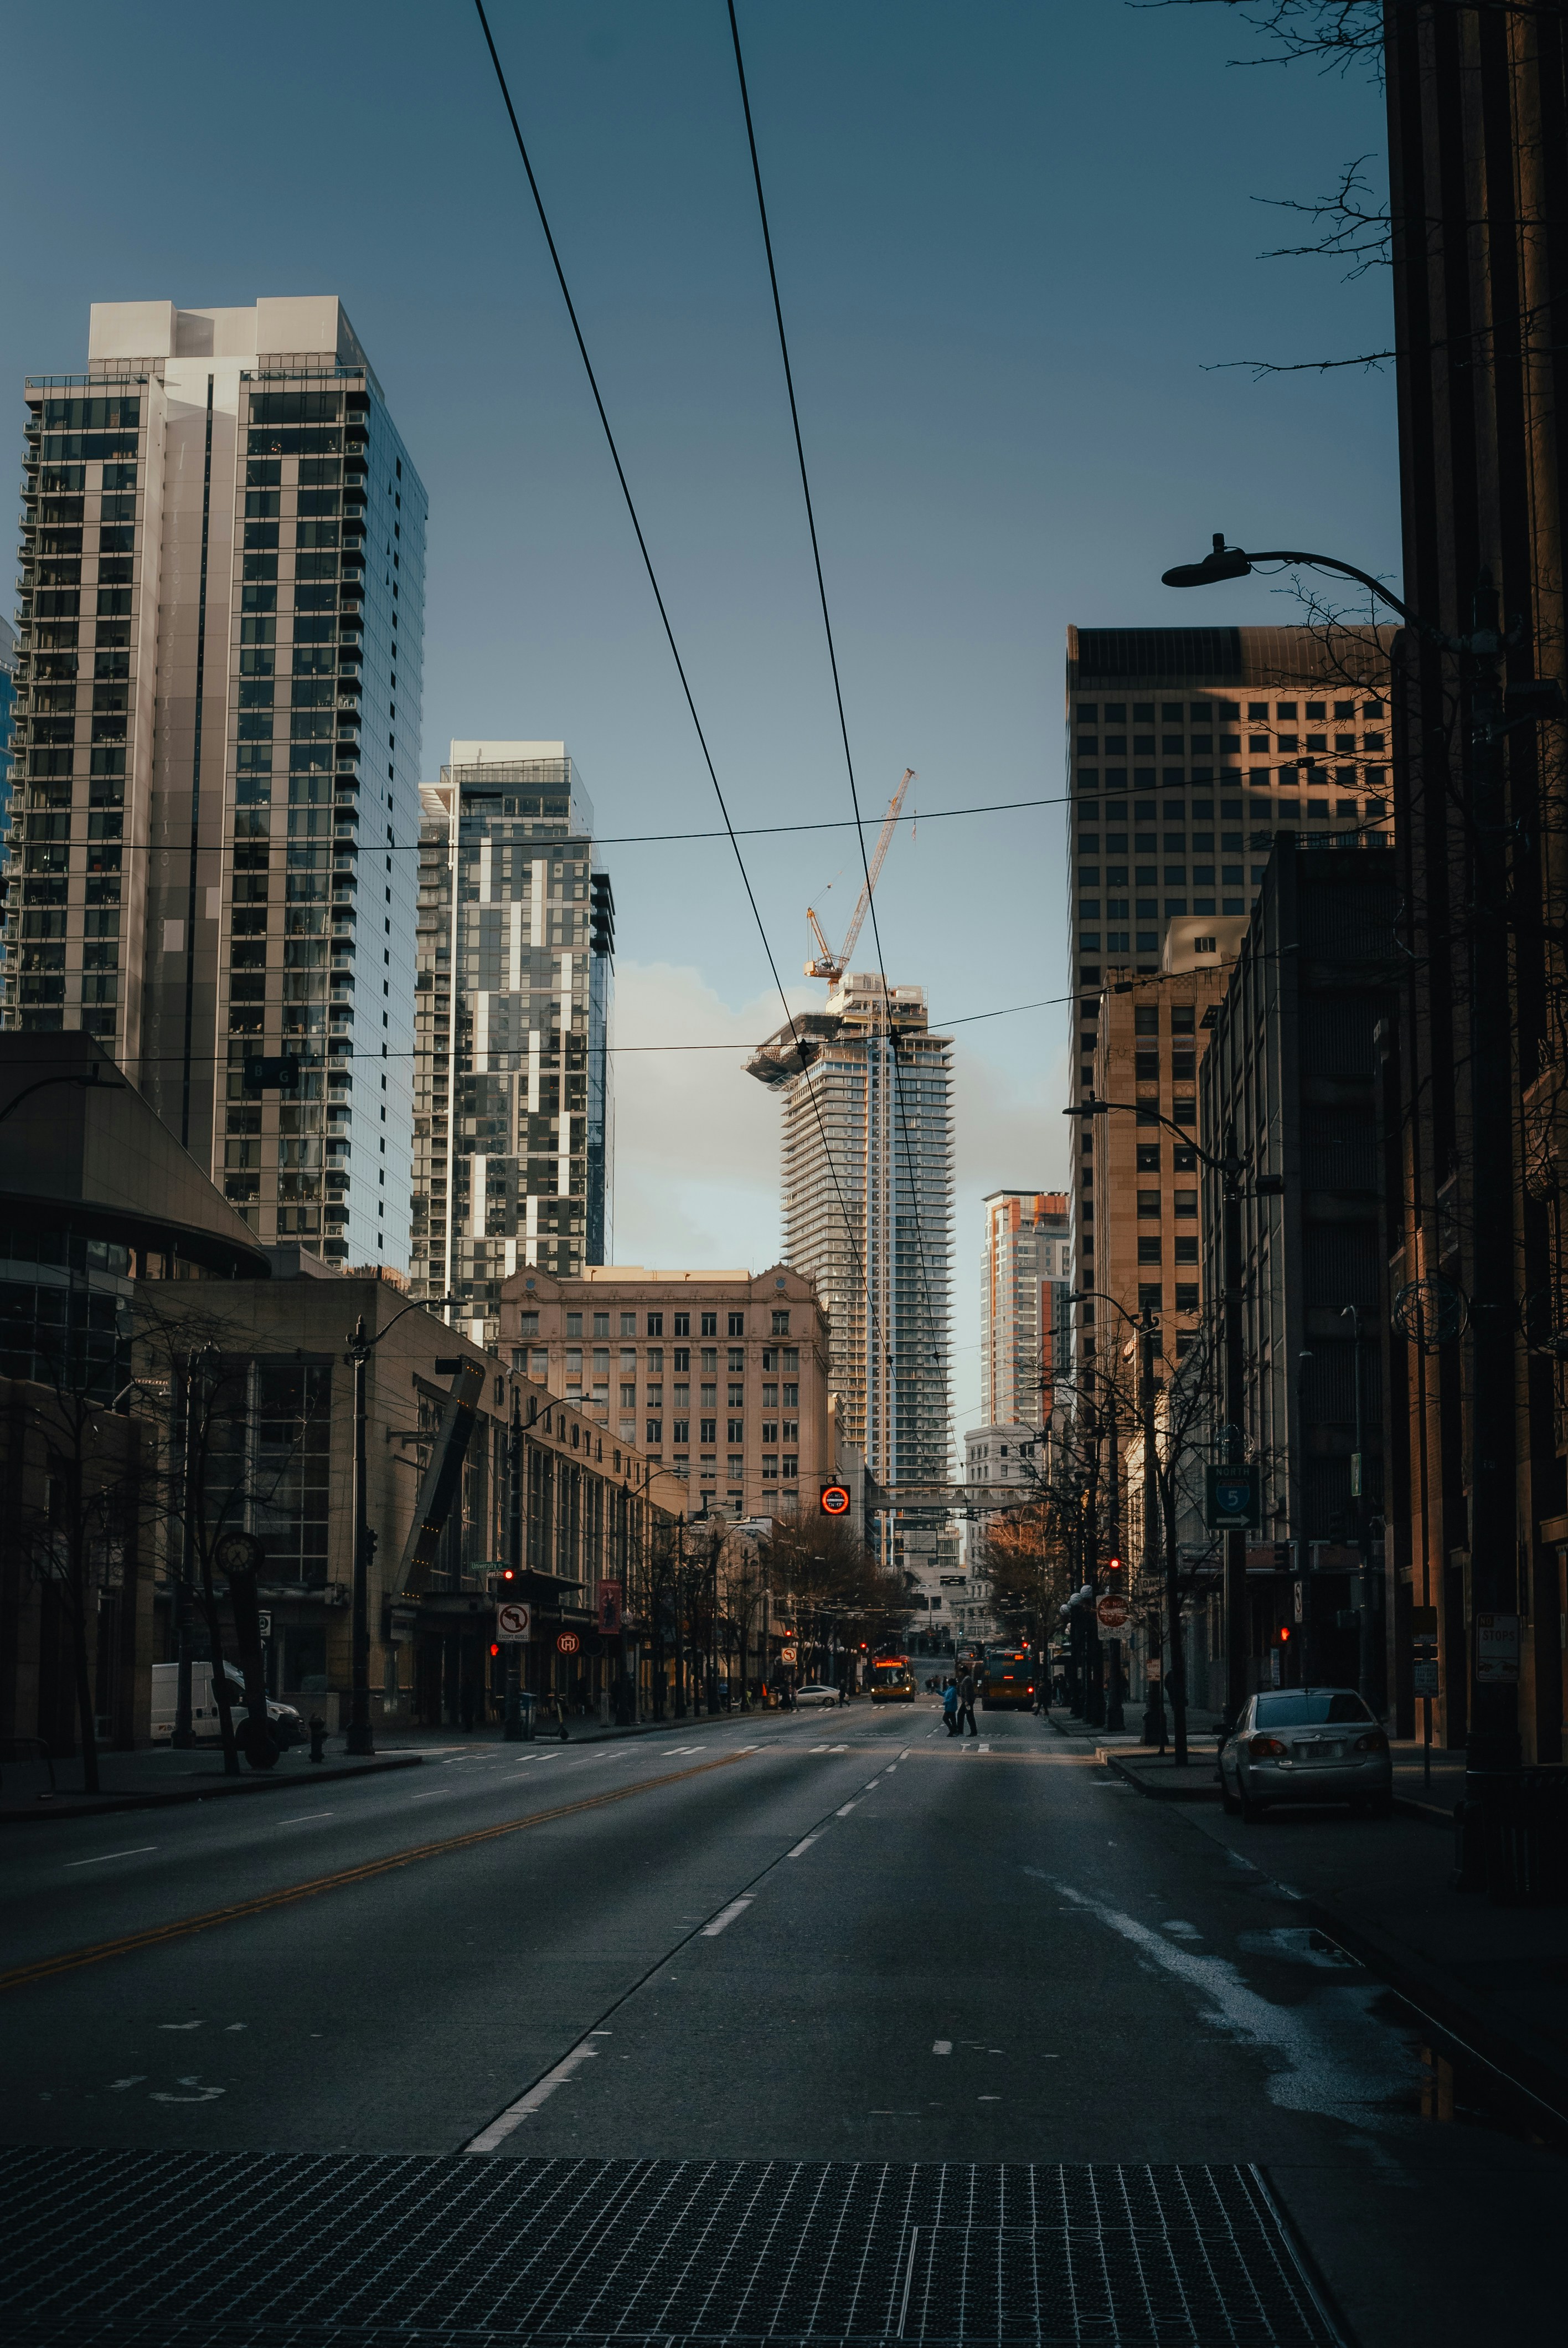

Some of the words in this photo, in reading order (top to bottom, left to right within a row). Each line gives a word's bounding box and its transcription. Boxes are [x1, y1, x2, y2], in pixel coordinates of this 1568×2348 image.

[254, 1065, 263, 1077] B
[279, 1070, 289, 1083] G
[1216, 1468, 1249, 1476] NORTH
[1228, 1490, 1239, 1506] 5
[1480, 1616, 1492, 1625] NO
[1483, 1630, 1515, 1641] STOPS
